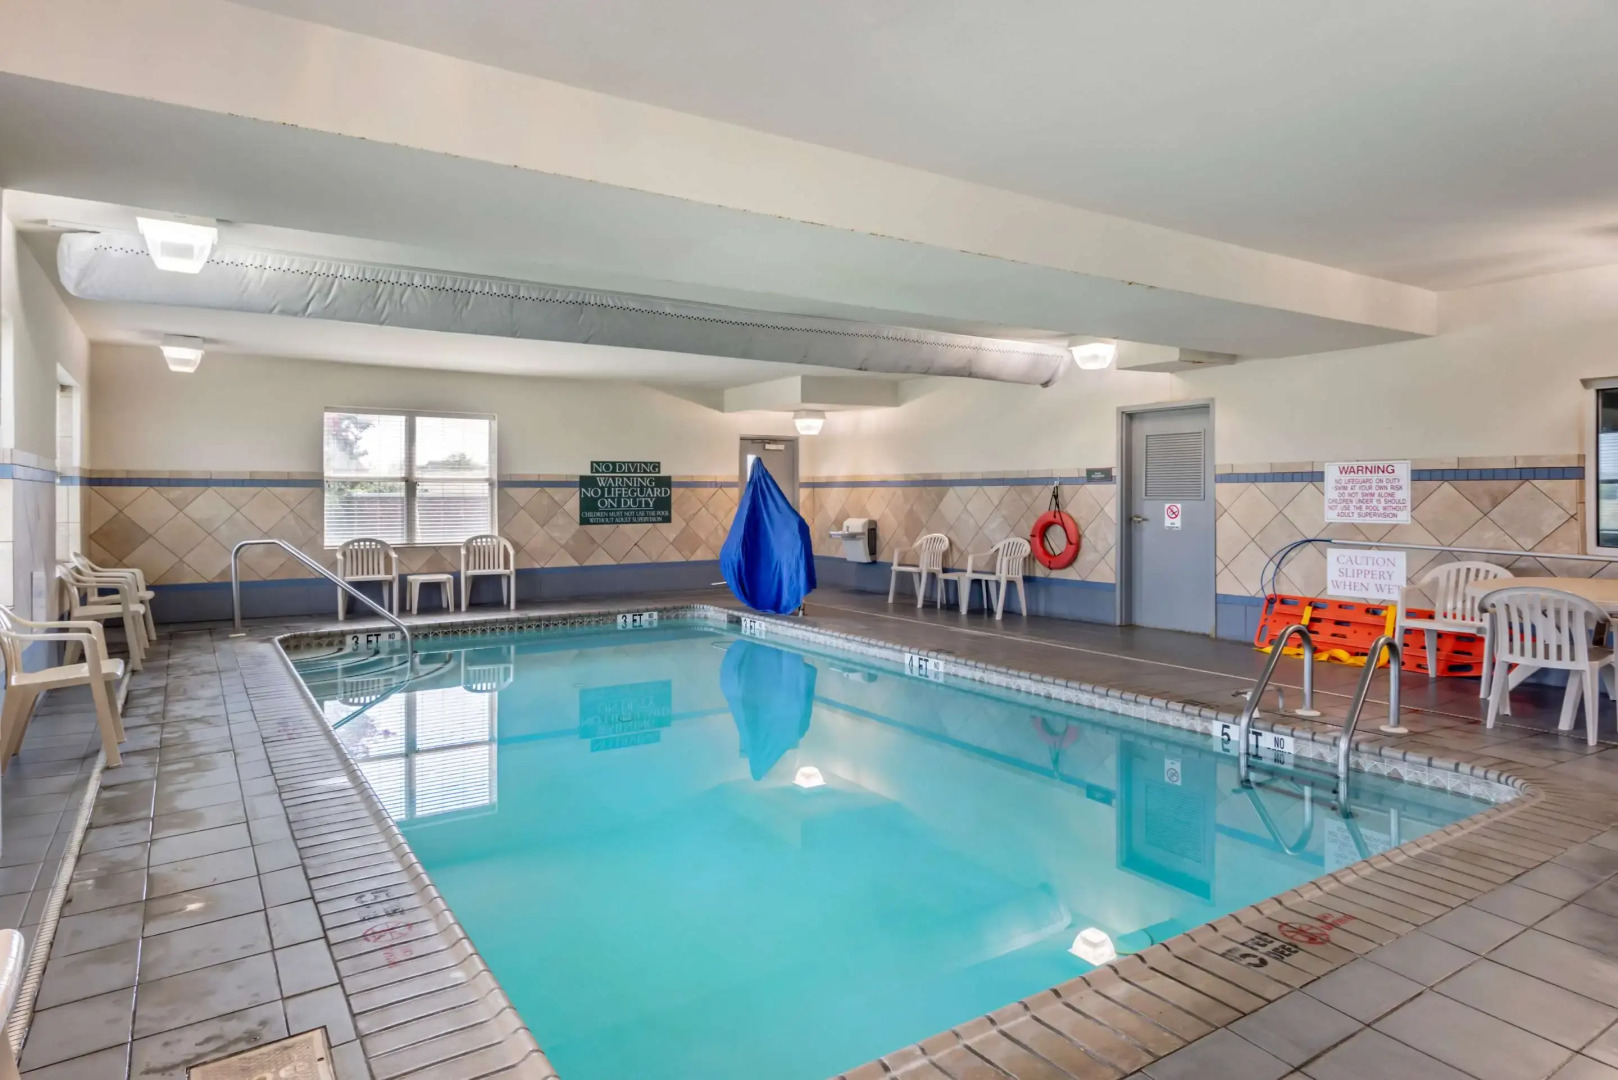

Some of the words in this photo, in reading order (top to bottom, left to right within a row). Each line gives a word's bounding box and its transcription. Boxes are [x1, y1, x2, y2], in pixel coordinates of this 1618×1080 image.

[592, 463, 613, 473] NO
[616, 463, 659, 473] DIVING
[1338, 465, 1395, 474] WARNING
[596, 477, 655, 487] WARNING
[581, 488, 601, 498] NO
[604, 487, 670, 497] LIFEGUARD
[598, 498, 617, 508] ON
[621, 498, 656, 508] DUTY
[1336, 554, 1396, 567] CAUTION
[1338, 568, 1394, 580] SLIPPERY
[1331, 580, 1370, 592] WHEN
[351, 635, 359, 645] 3
[366, 633, 381, 644] FT
[919, 657, 929, 670] FT
[1221, 723, 1231, 741] 5
[1274, 736, 1285, 750] NO
